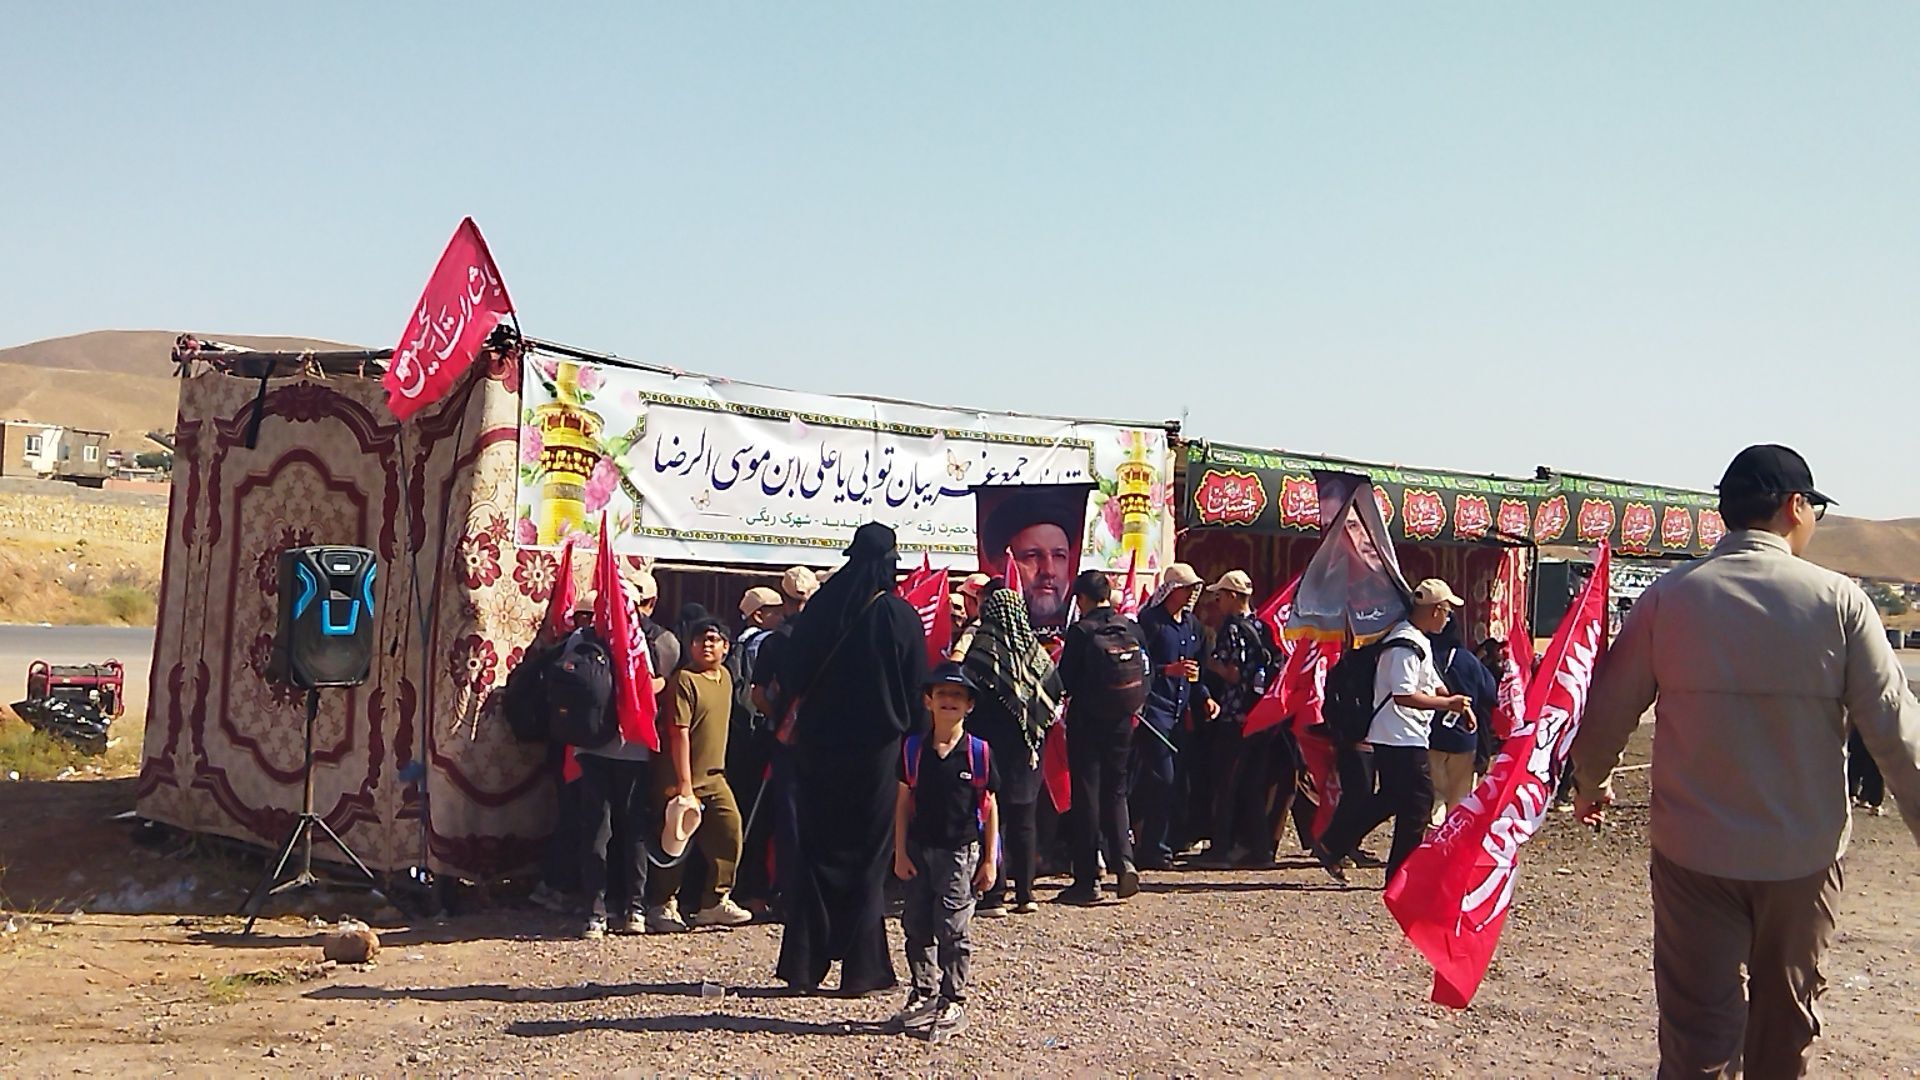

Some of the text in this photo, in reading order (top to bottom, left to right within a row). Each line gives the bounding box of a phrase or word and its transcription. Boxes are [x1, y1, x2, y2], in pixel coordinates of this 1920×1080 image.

[654, 426, 712, 476] الرضا
[711, 443, 770, 491] موسی
[761, 455, 801, 498] ابن
[745, 507, 776, 527] ریگی
[780, 511, 812, 528] شهرک
[917, 519, 936, 536] رقیه
[938, 522, 969, 537] حضرت
